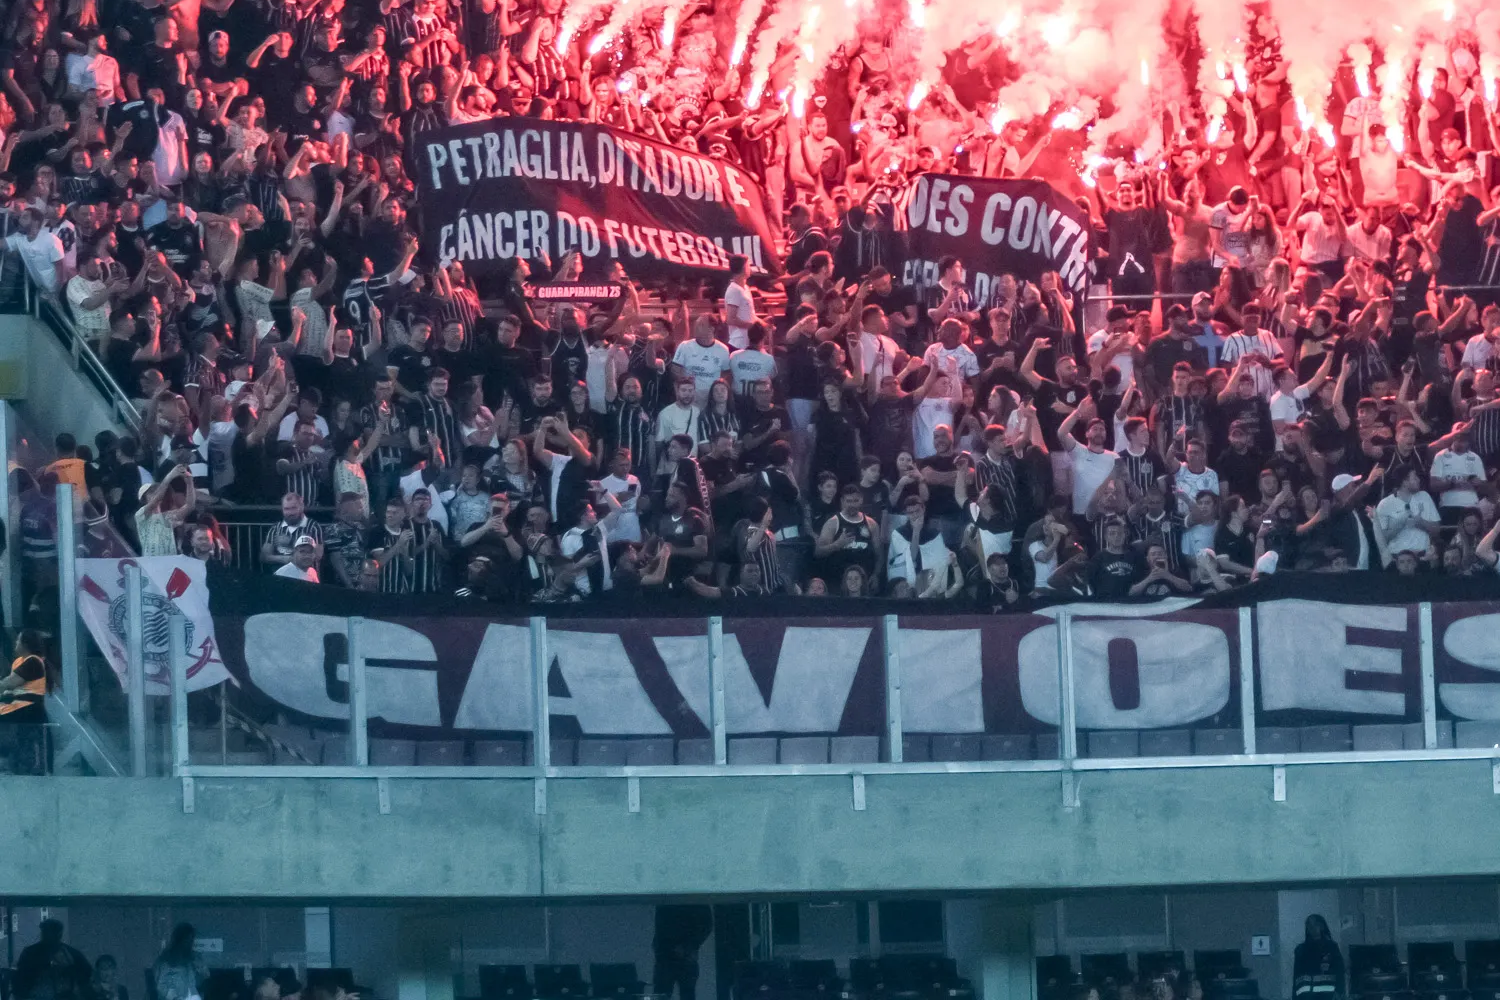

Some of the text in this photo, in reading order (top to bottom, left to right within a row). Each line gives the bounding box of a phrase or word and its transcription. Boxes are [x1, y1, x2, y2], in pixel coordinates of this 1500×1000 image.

[598, 132, 723, 202] DITADOR
[557, 211, 602, 258] DO
[538, 285, 607, 299] GUARAPIRANGA
